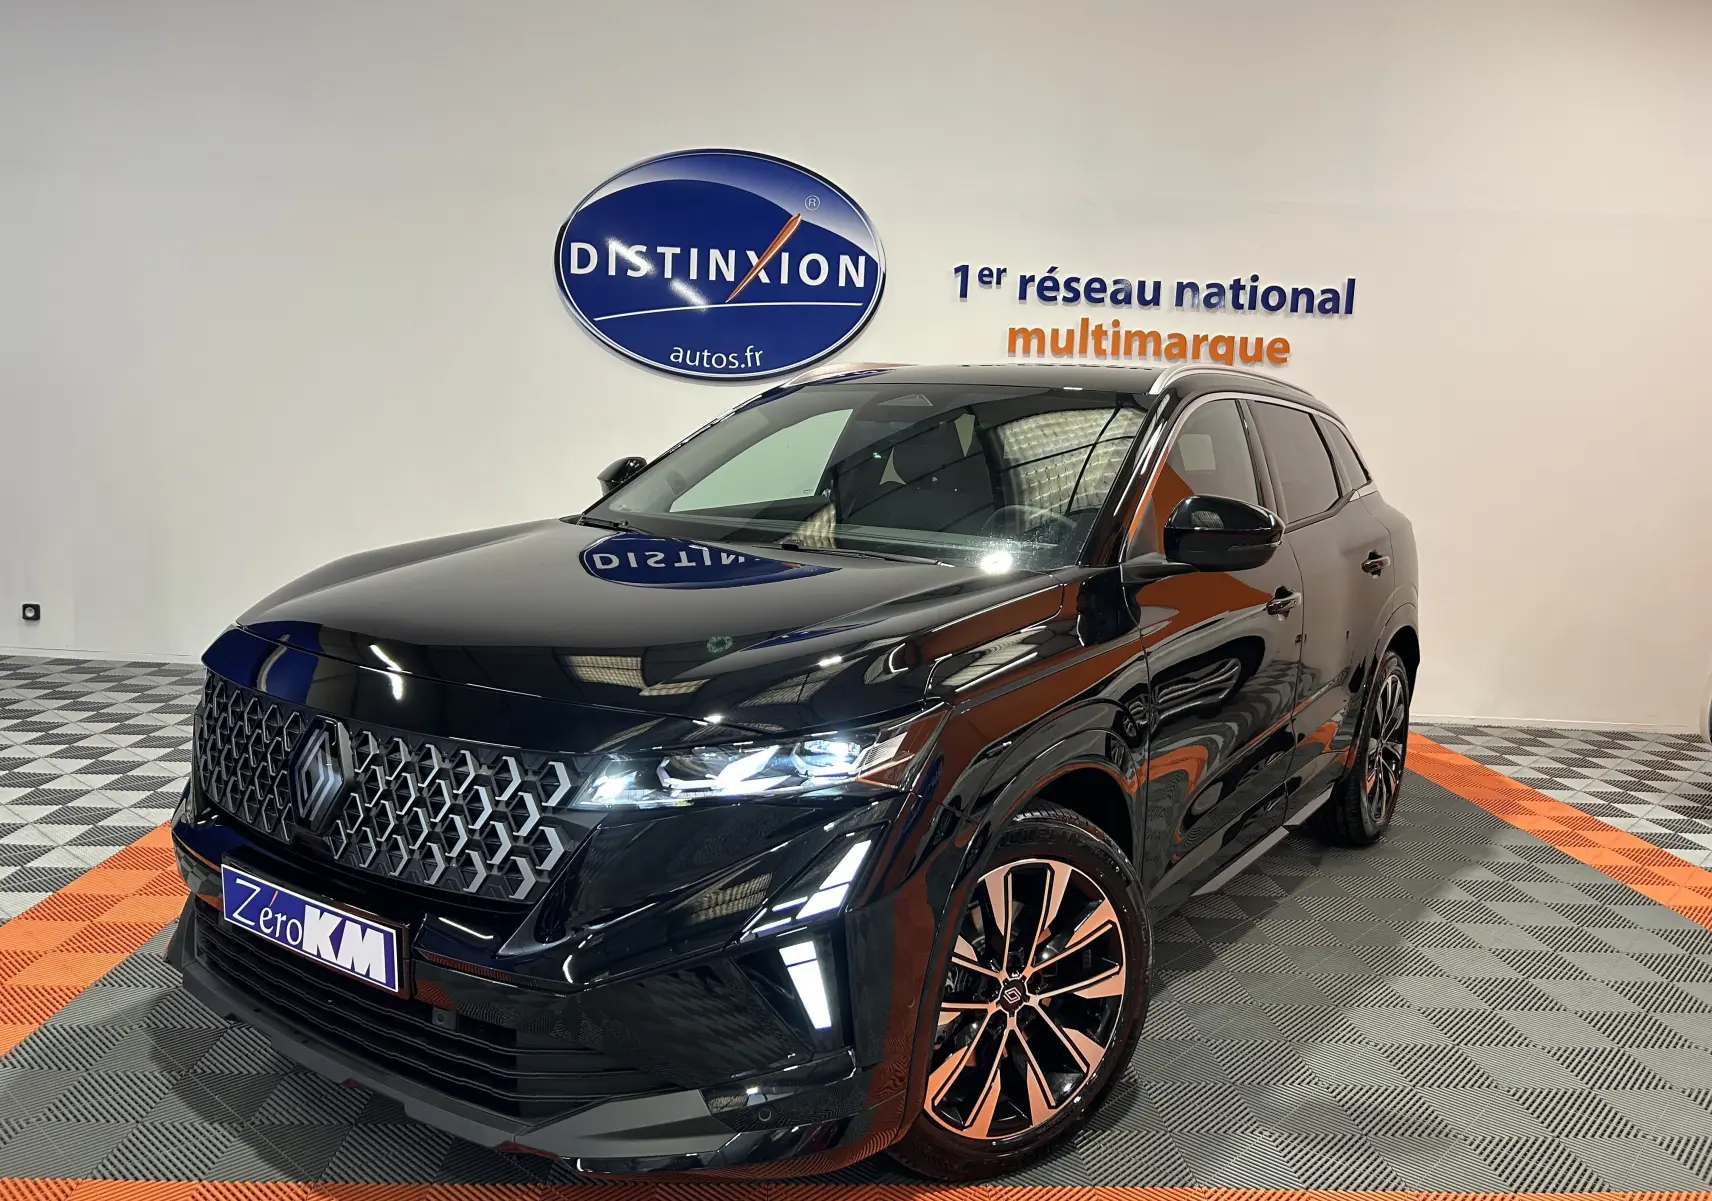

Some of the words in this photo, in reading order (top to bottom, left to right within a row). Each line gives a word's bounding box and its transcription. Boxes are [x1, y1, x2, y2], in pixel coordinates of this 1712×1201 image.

[569, 237, 867, 291] DISTINXION
[1018, 266, 1161, 307] réseau
[1174, 273, 1356, 315] national
[669, 345, 763, 369] autos.fr
[1007, 317, 1291, 366] multimarque
